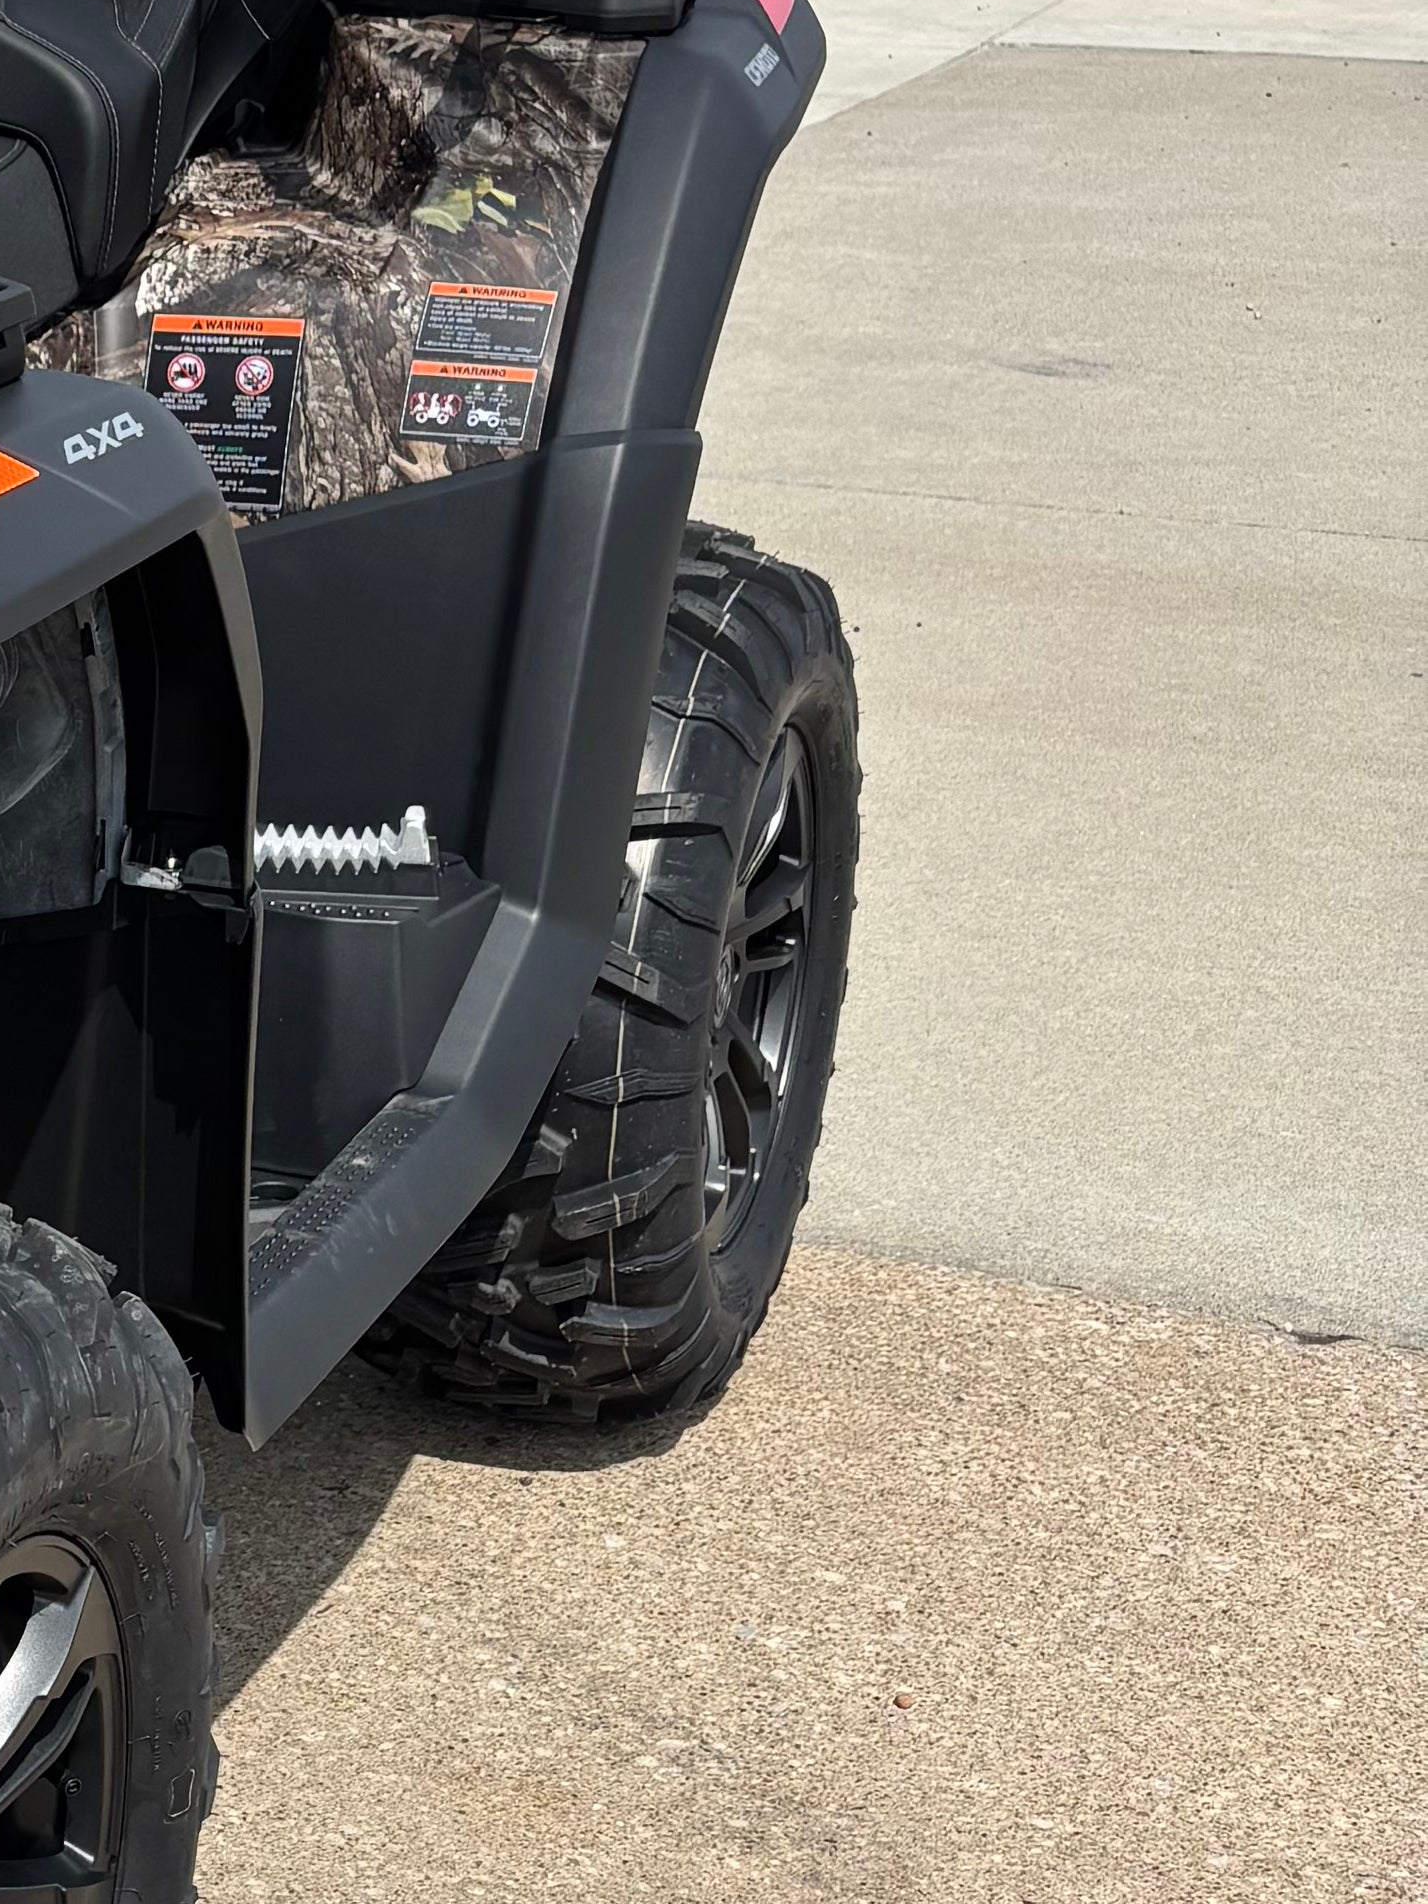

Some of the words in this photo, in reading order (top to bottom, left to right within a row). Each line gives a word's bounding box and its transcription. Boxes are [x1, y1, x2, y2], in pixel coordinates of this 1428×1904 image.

[472, 287, 527, 299] WARNING
[205, 319, 264, 332] WARNING
[452, 366, 507, 378] WARNING
[63, 411, 144, 465] 4X4
